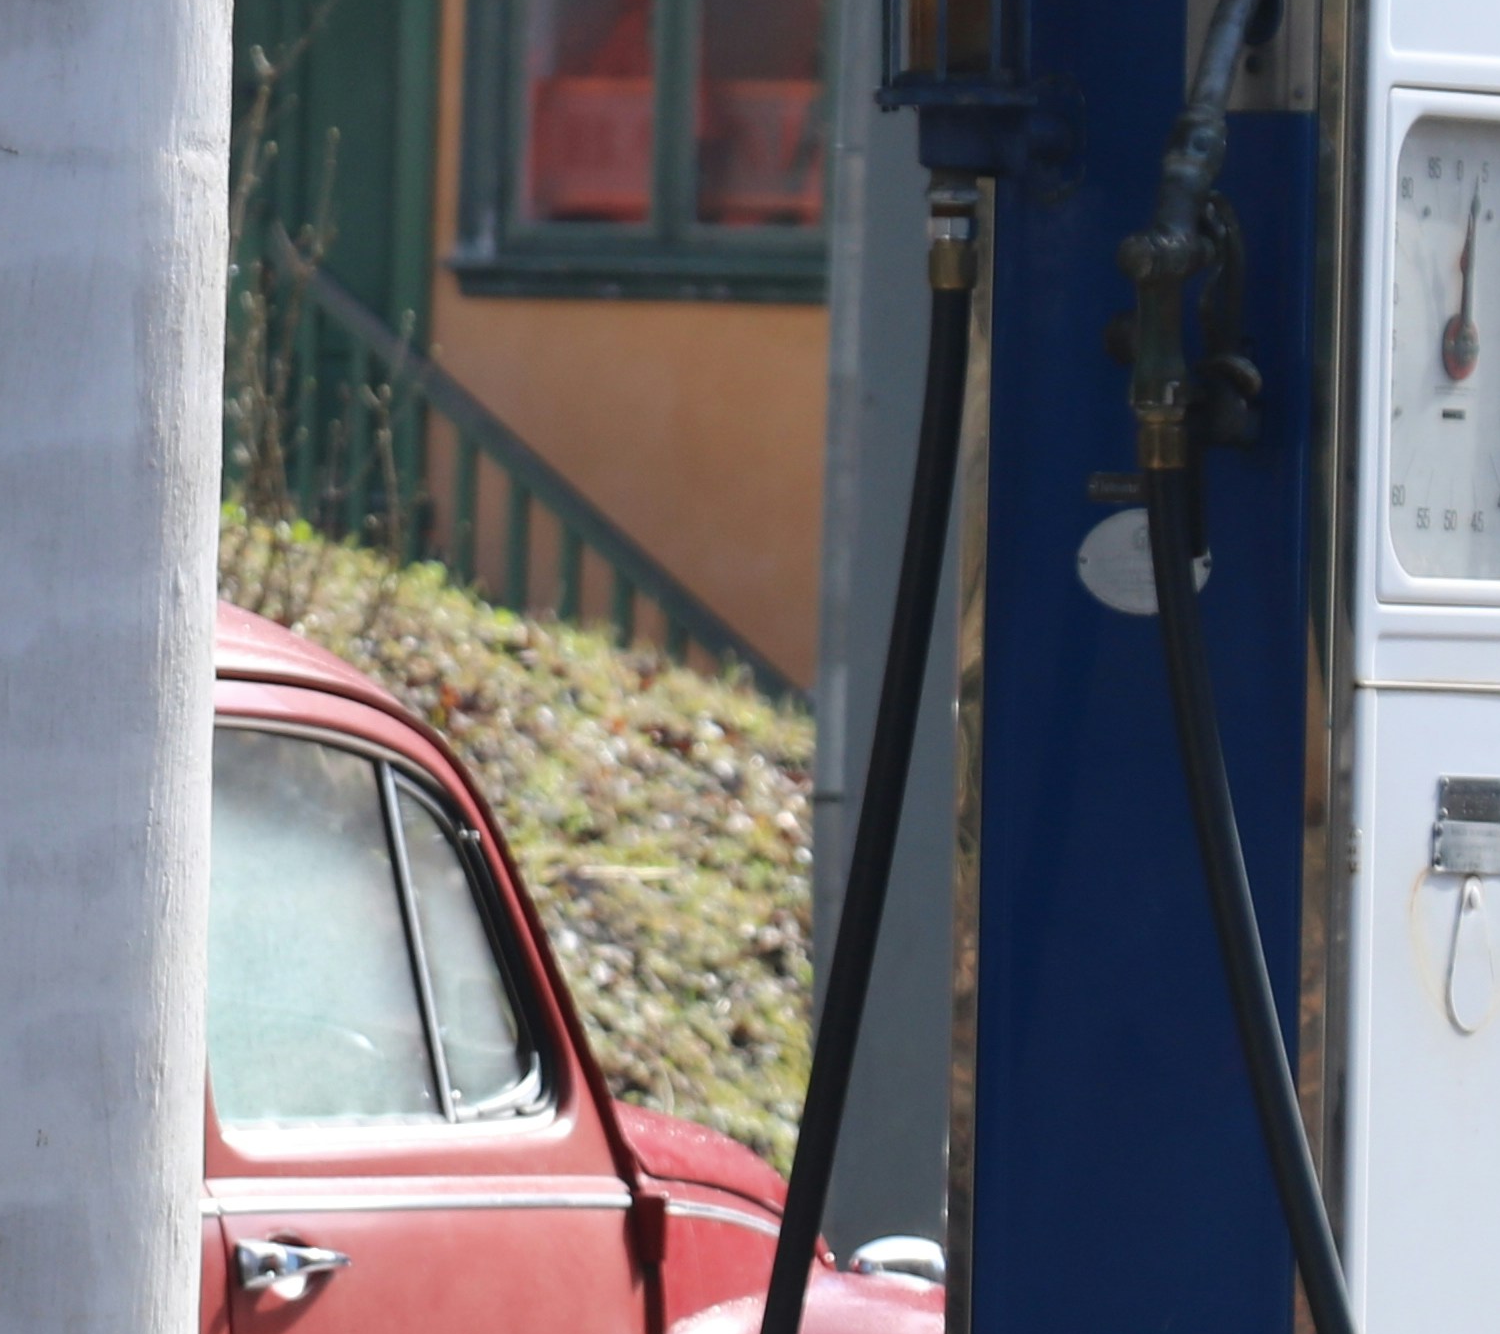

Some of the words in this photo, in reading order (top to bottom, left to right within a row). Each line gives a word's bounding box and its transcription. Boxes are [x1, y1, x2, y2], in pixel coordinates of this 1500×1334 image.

[1416, 507, 1430, 529] 55
[1443, 509, 1457, 531] 50
[1471, 510, 1484, 532] 45
